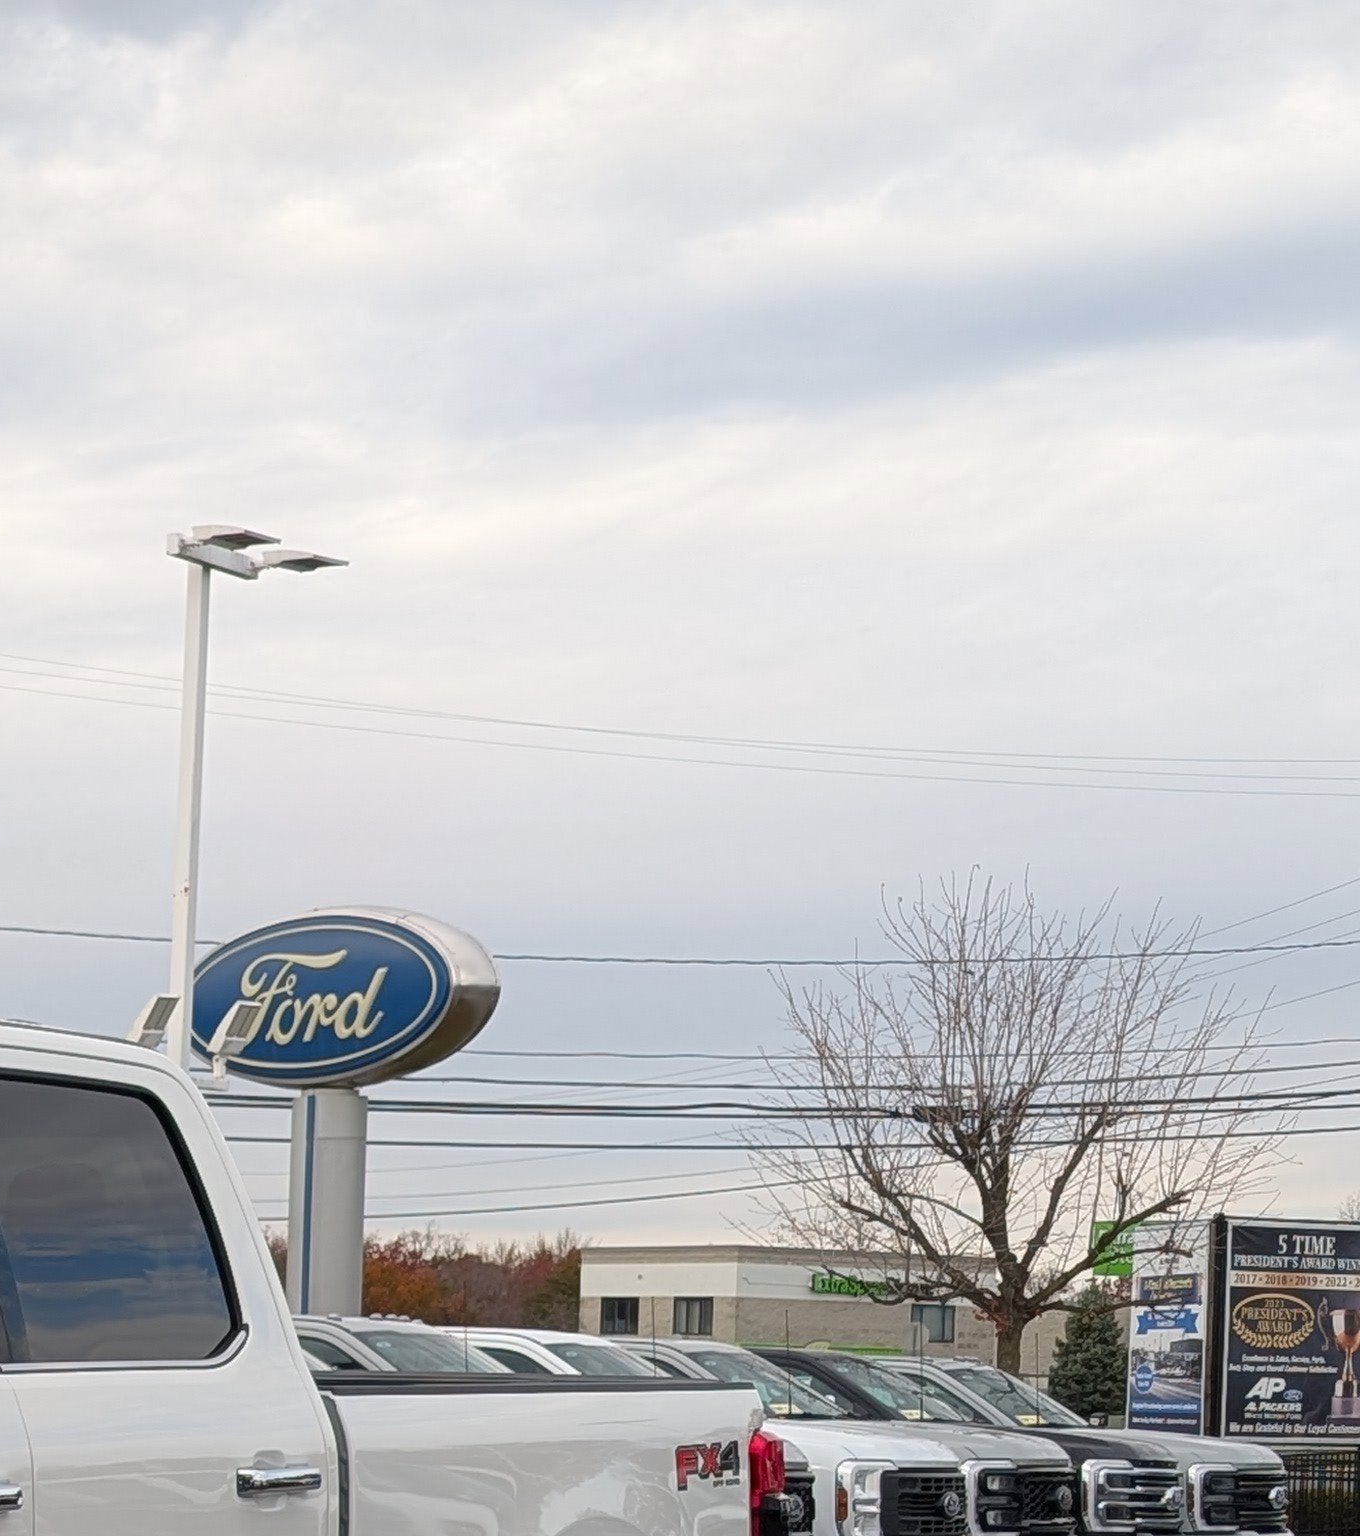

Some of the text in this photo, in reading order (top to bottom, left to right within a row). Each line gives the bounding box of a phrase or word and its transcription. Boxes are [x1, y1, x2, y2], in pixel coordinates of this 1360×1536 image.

[240, 949, 389, 1046] Ford
[1277, 1234, 1336, 1256] 5 TIME
[1233, 1254, 1299, 1269] PRESIDENT'S
[1300, 1256, 1336, 1270] AWARD
[1234, 1273, 1257, 1285] 2017
[1265, 1273, 1287, 1285] 2018
[1295, 1275, 1318, 1286] 2019
[1325, 1276, 1347, 1287] 2022
[1241, 1306, 1308, 1320] PRESIDENT'S
[1256, 1320, 1292, 1333] AWARD
[1244, 1377, 1286, 1399] AP
[675, 1440, 740, 1491] FX4
